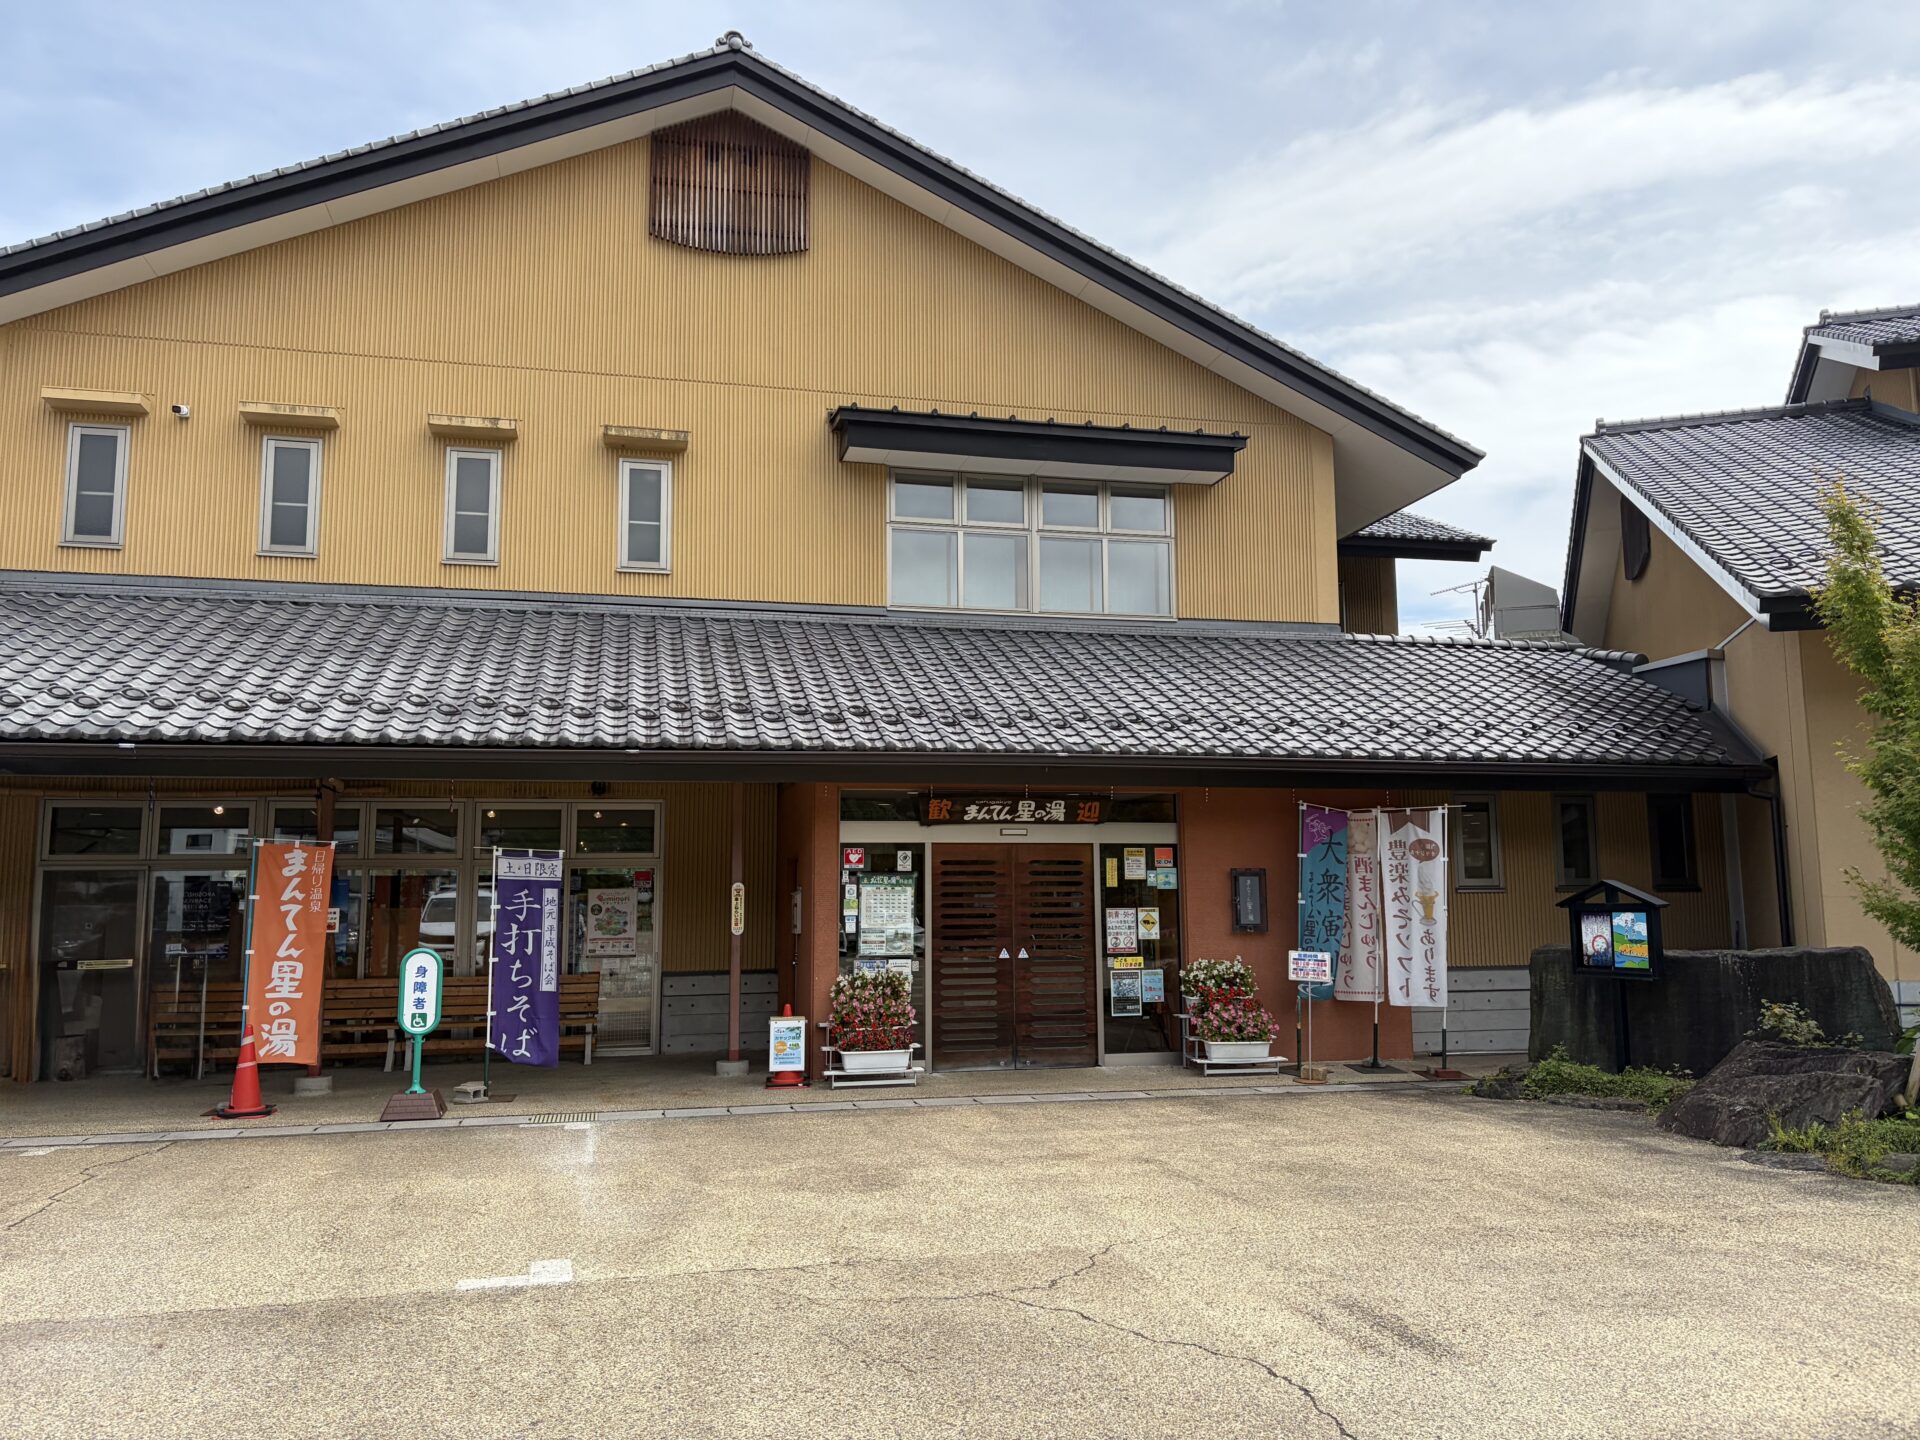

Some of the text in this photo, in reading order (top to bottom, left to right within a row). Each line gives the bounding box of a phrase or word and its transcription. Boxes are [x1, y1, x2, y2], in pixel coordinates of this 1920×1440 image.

[928, 799, 1100, 823] 歓 まんてん星の湯 迎
[309, 850, 326, 913] 日帰り温泉
[503, 862, 559, 877] 土・日限定
[258, 849, 308, 1058] まんてん星の湯
[500, 888, 542, 1058] 手打ちそば
[412, 965, 429, 1010] 身障者
